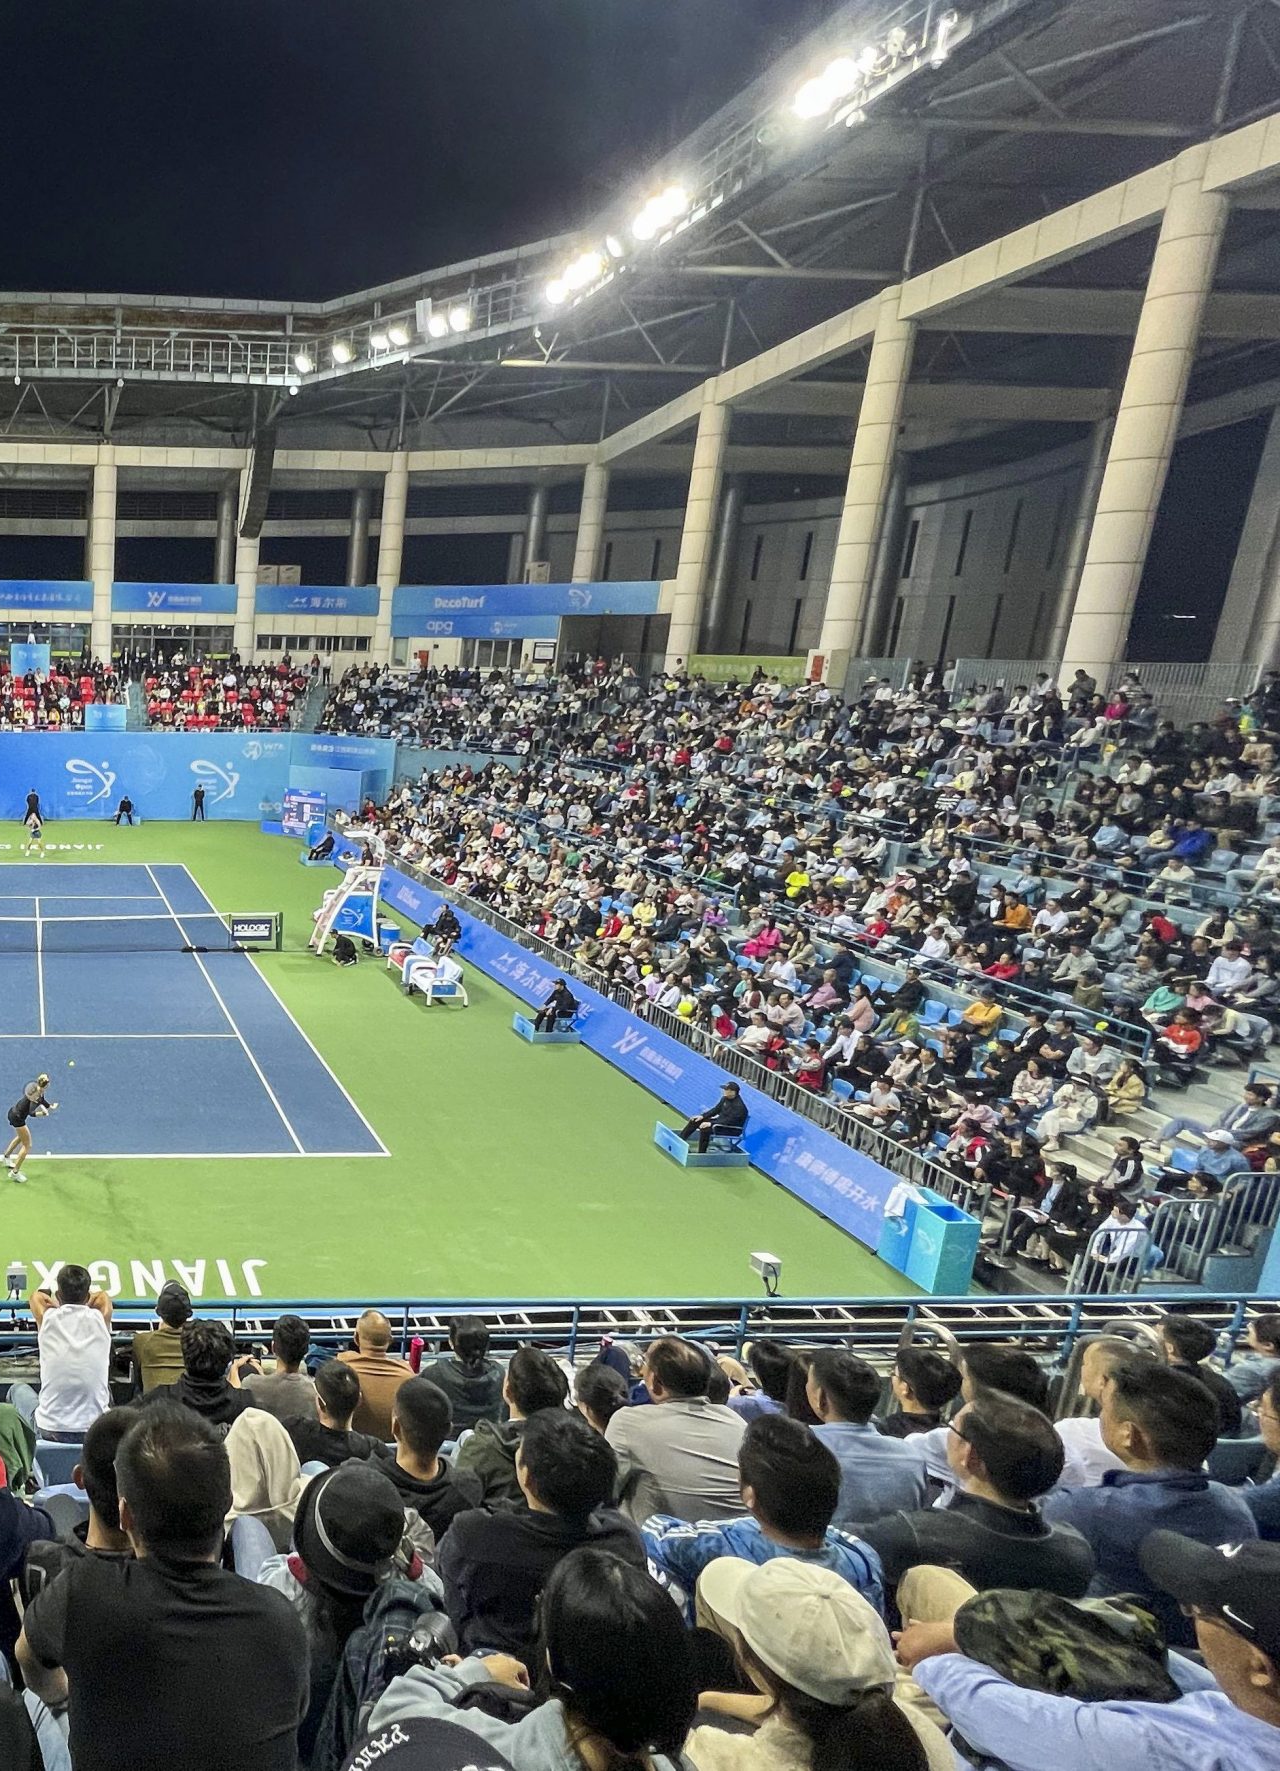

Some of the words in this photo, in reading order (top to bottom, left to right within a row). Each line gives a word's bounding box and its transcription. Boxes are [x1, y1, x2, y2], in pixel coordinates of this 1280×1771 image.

[434, 595, 486, 608] DecoTurf
[426, 620, 454, 635] apg
[233, 923, 270, 932] HOLOGIC
